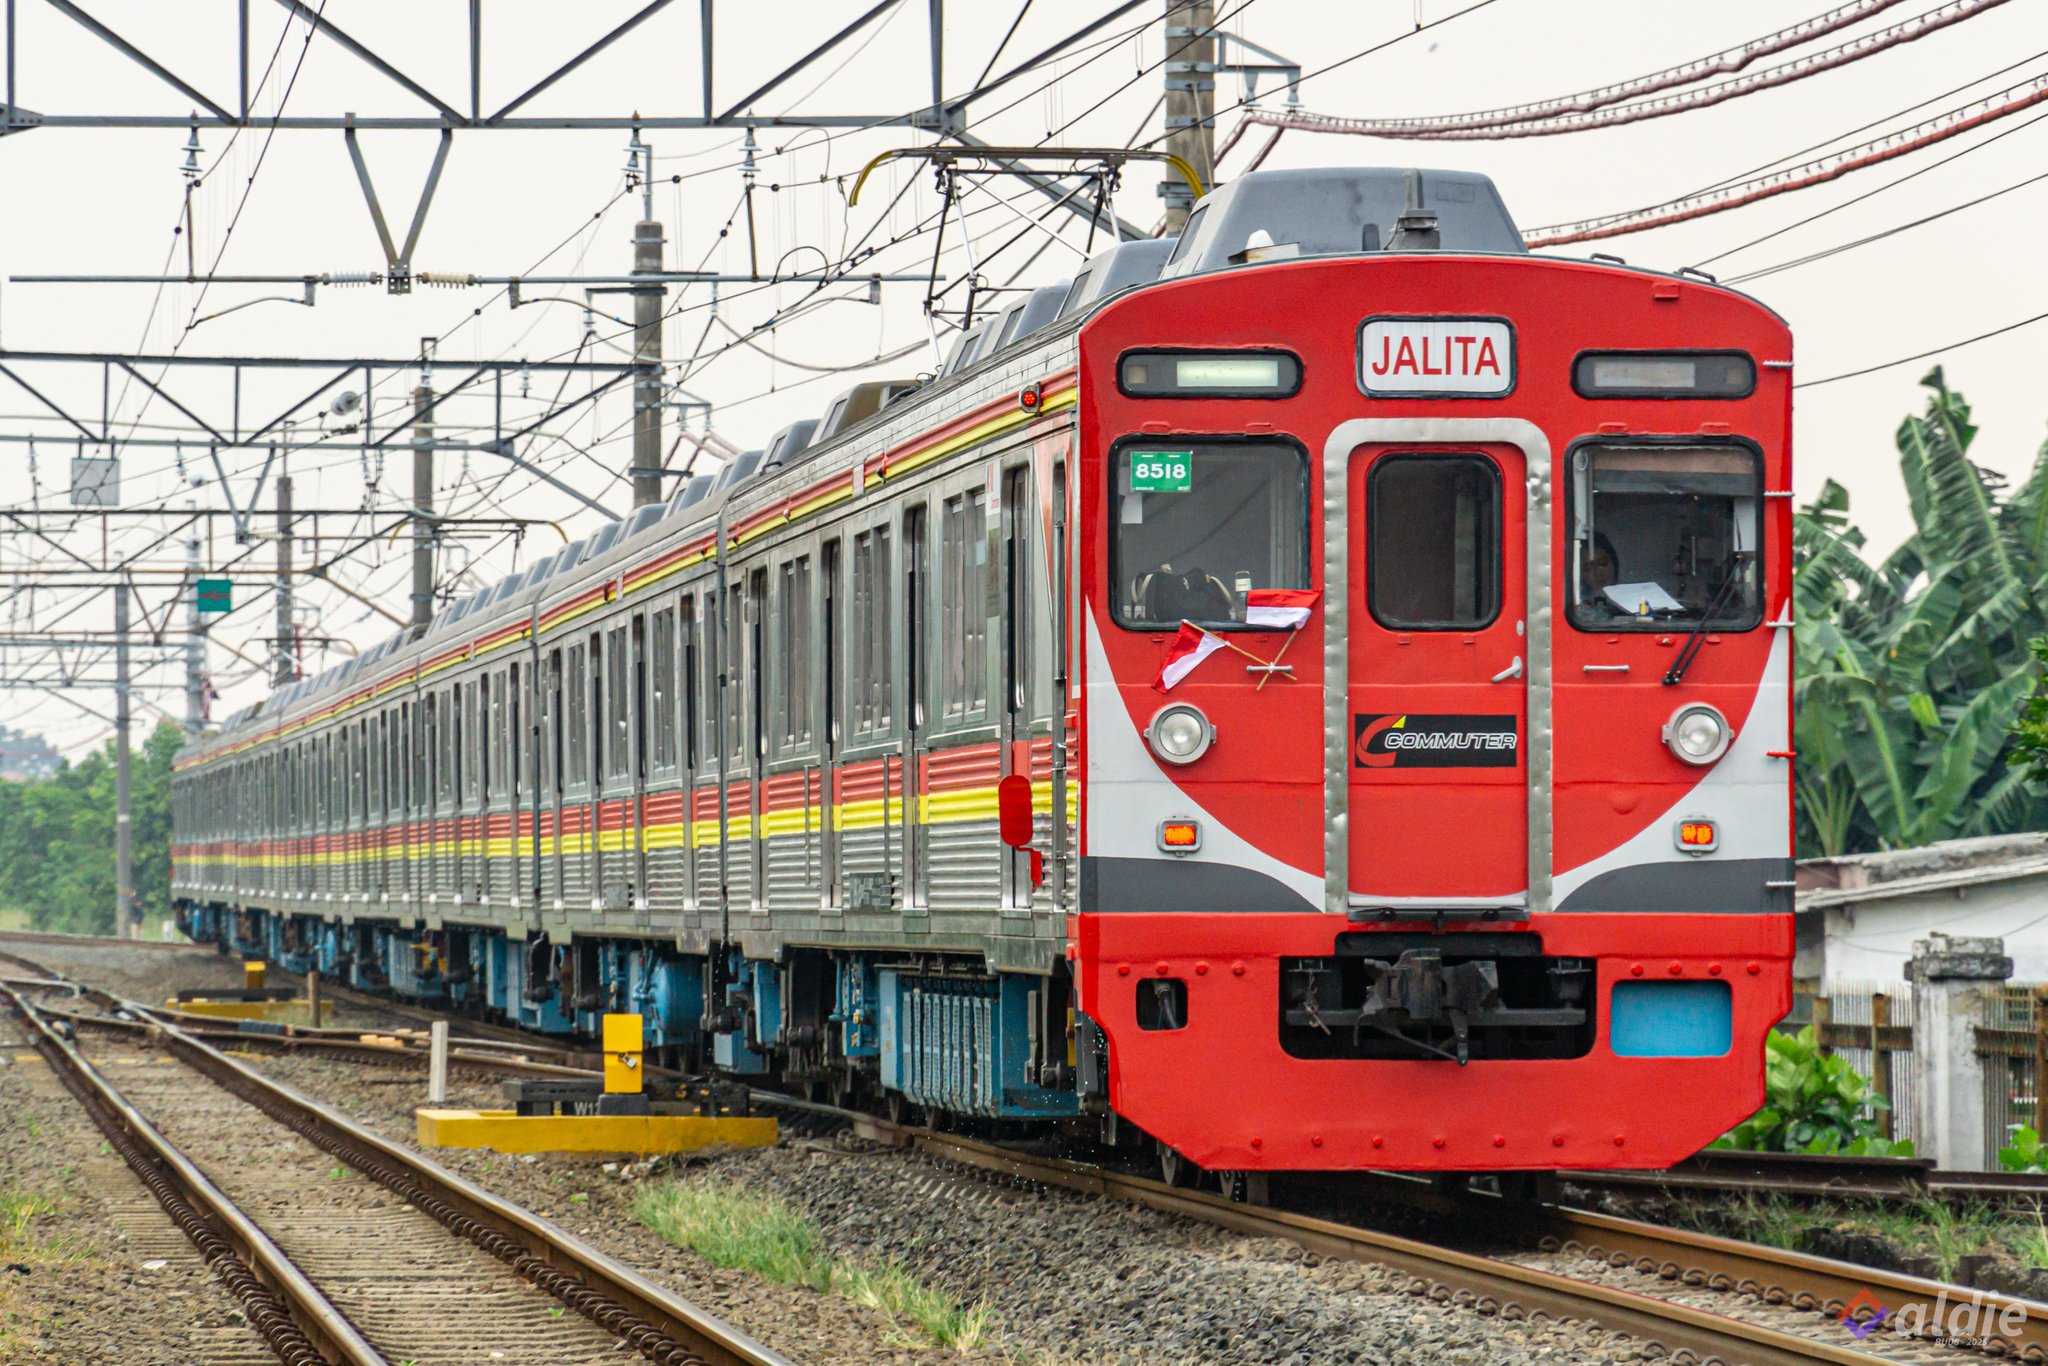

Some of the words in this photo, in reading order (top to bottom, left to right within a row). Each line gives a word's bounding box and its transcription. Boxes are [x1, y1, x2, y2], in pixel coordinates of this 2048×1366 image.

[1372, 336, 1500, 375] JALITA
[1136, 463, 1187, 479] 8518
[1384, 732, 1517, 750] COMMUTER
